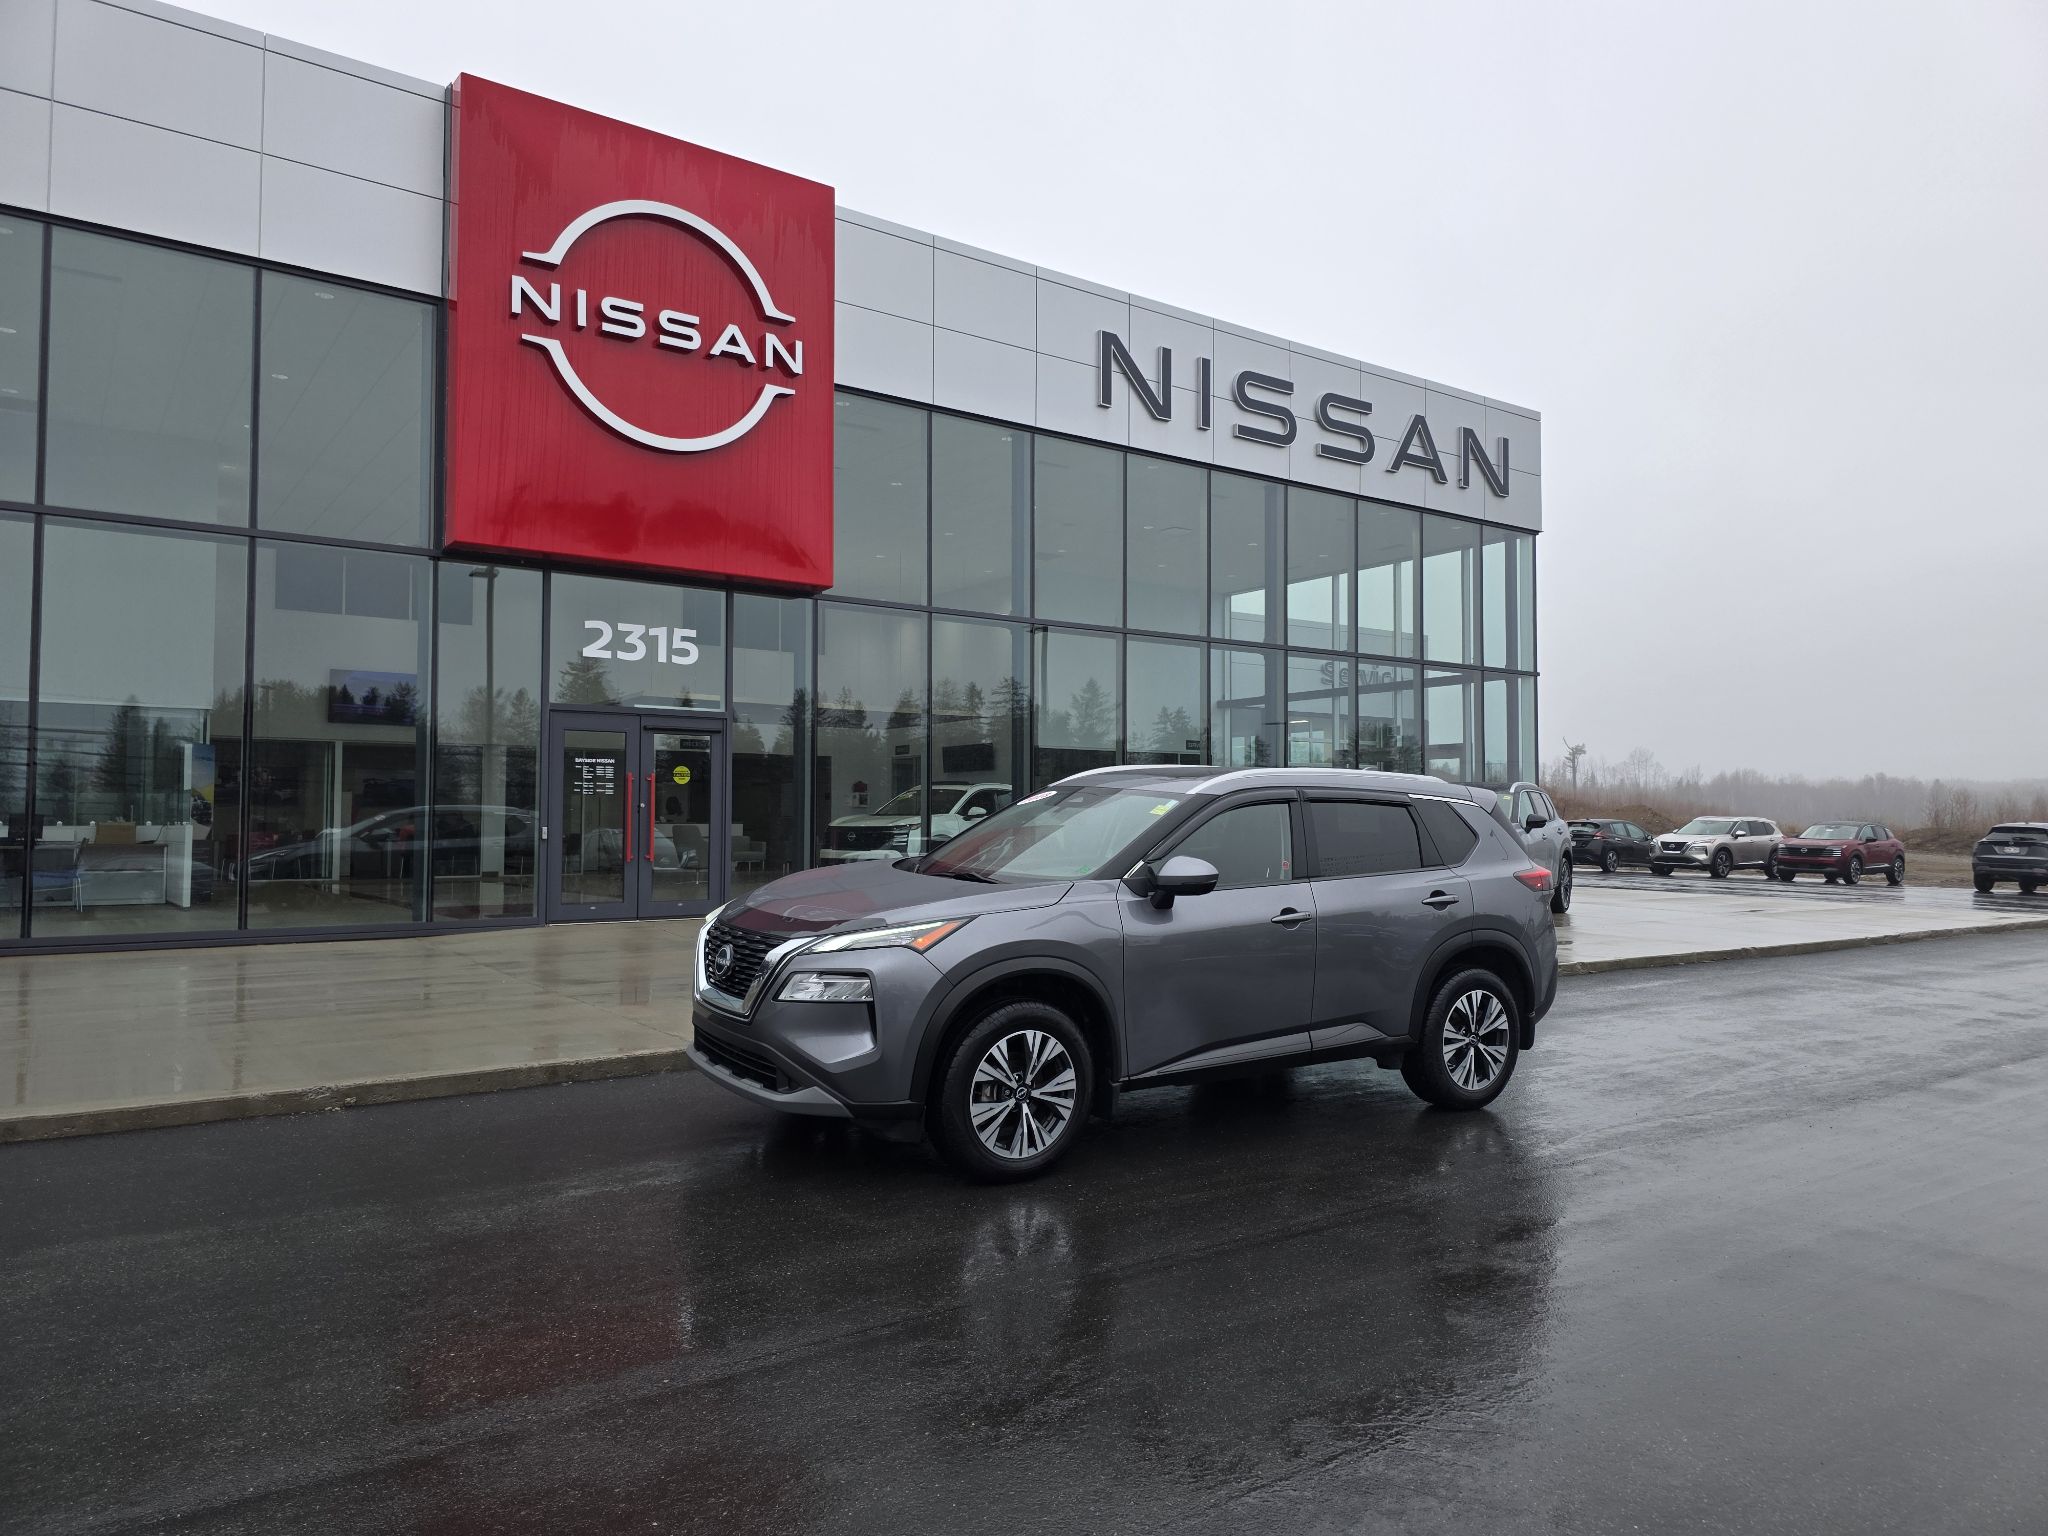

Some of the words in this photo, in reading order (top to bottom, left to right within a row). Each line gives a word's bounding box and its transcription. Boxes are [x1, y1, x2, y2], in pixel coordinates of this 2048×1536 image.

[510, 274, 803, 376] NISSAN
[1098, 329, 1510, 498] NISSAN
[582, 620, 699, 665] 2315
